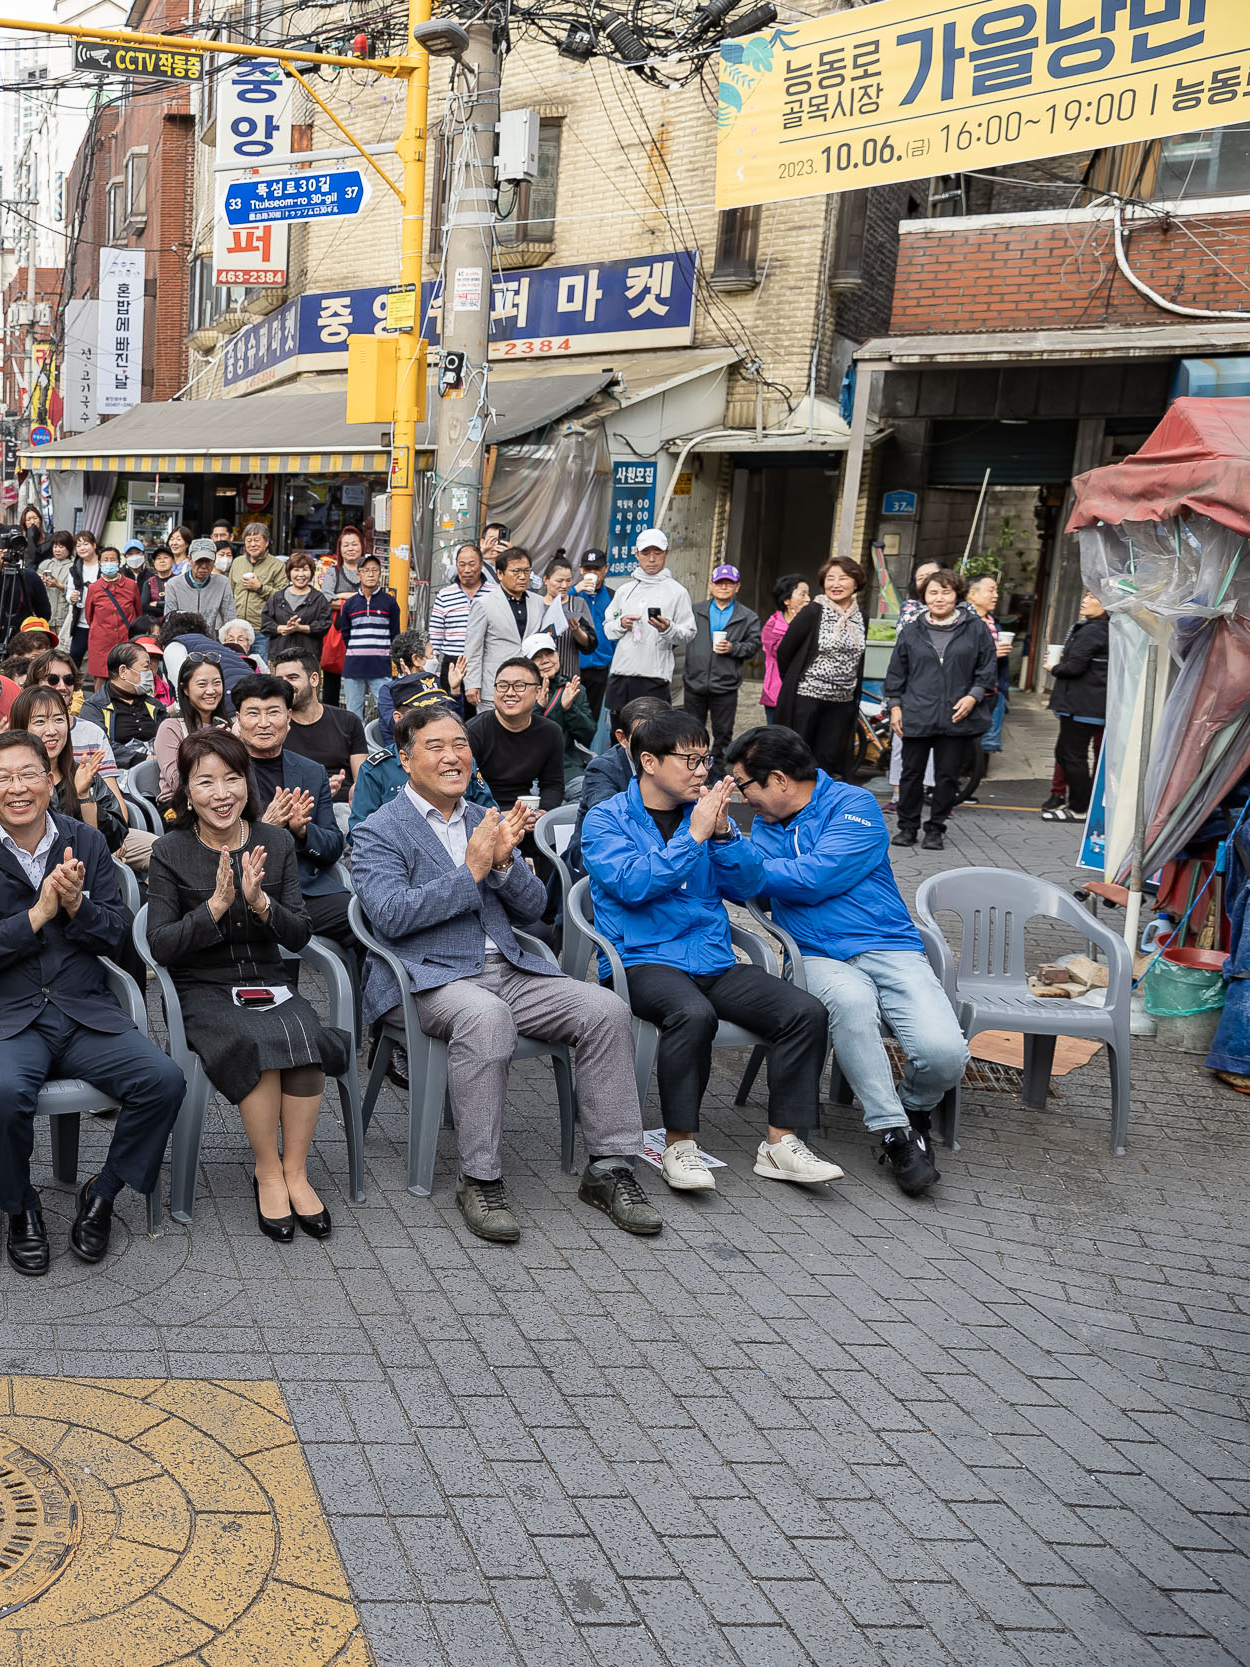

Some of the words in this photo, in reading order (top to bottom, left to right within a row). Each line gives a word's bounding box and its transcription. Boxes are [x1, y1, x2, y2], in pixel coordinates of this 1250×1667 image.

[115, 50, 156, 72] CCTV
[158, 53, 202, 79] 작동중
[783, 39, 882, 97] 능동로
[782, 82, 884, 130] 골목시장
[778, 158, 818, 180] 2023.
[821, 134, 903, 174] 10.06.
[905, 138, 931, 159] (금)
[940, 88, 1137, 153] 16:00~19:00
[250, 197, 308, 210] Ttukseom-ro
[310, 191, 338, 204] 30-gil
[344, 186, 359, 199] 37
[228, 198, 242, 210] 33
[218, 271, 283, 285] 463-2384
[115, 283, 132, 333] 혼밥에
[114, 336, 131, 368] 빠진
[115, 373, 130, 390] 날
[616, 466, 655, 484] 사원모집
[844, 813, 862, 823] TEAM
